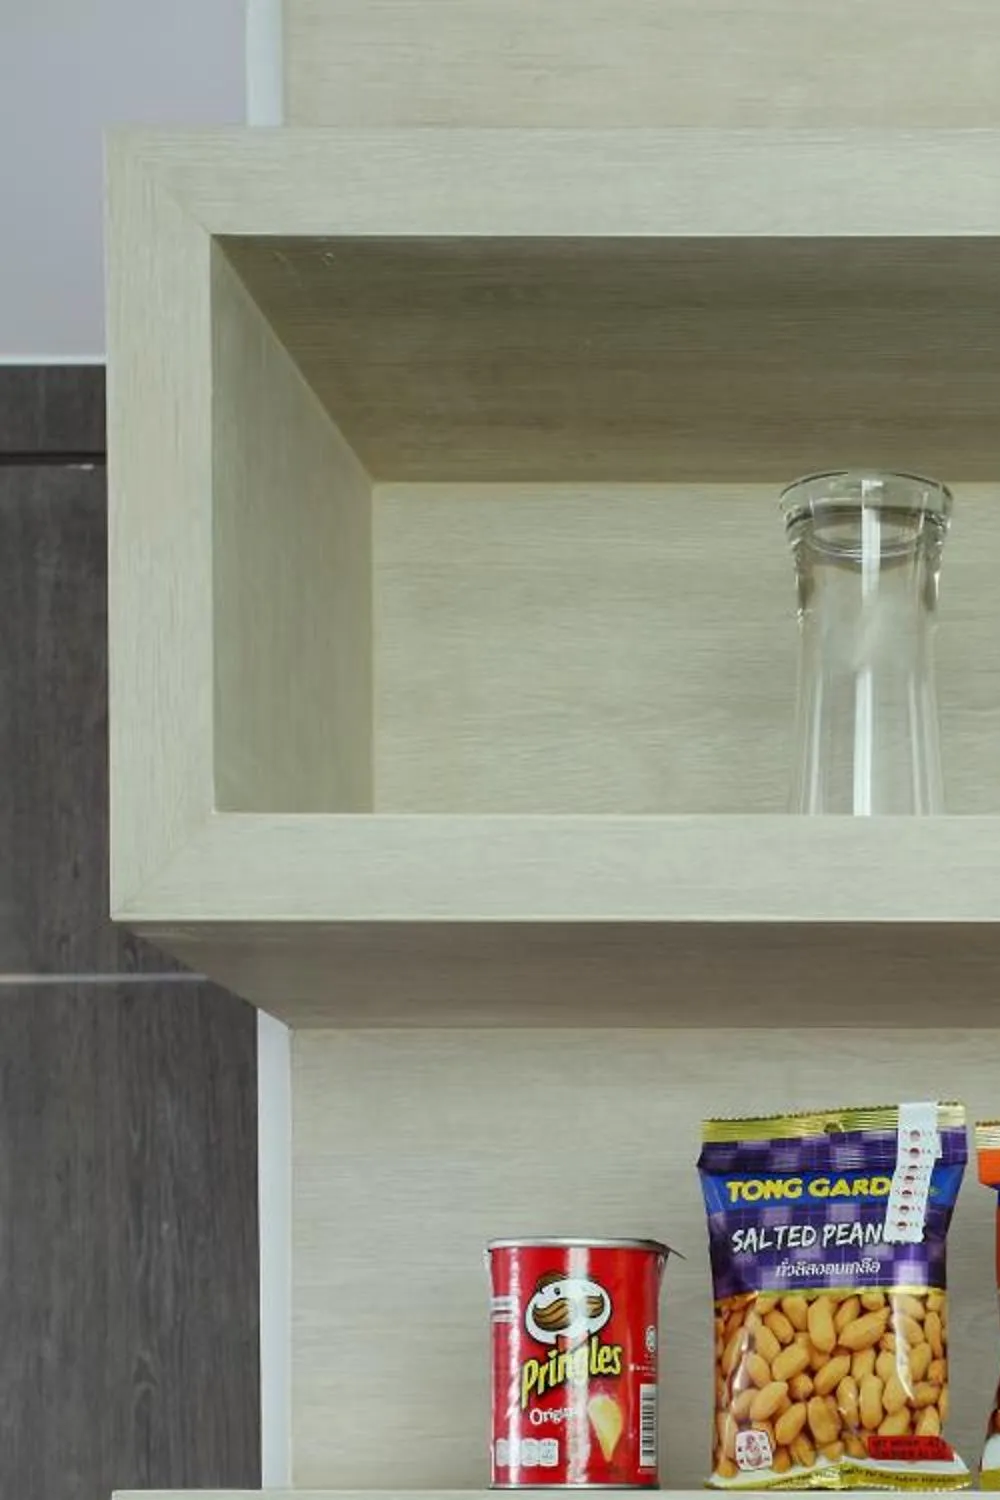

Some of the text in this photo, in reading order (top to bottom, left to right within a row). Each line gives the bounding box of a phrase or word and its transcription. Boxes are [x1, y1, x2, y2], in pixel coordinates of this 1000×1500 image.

[726, 1177, 803, 1203] TONG
[731, 1221, 916, 1253] SALTED PEAN
